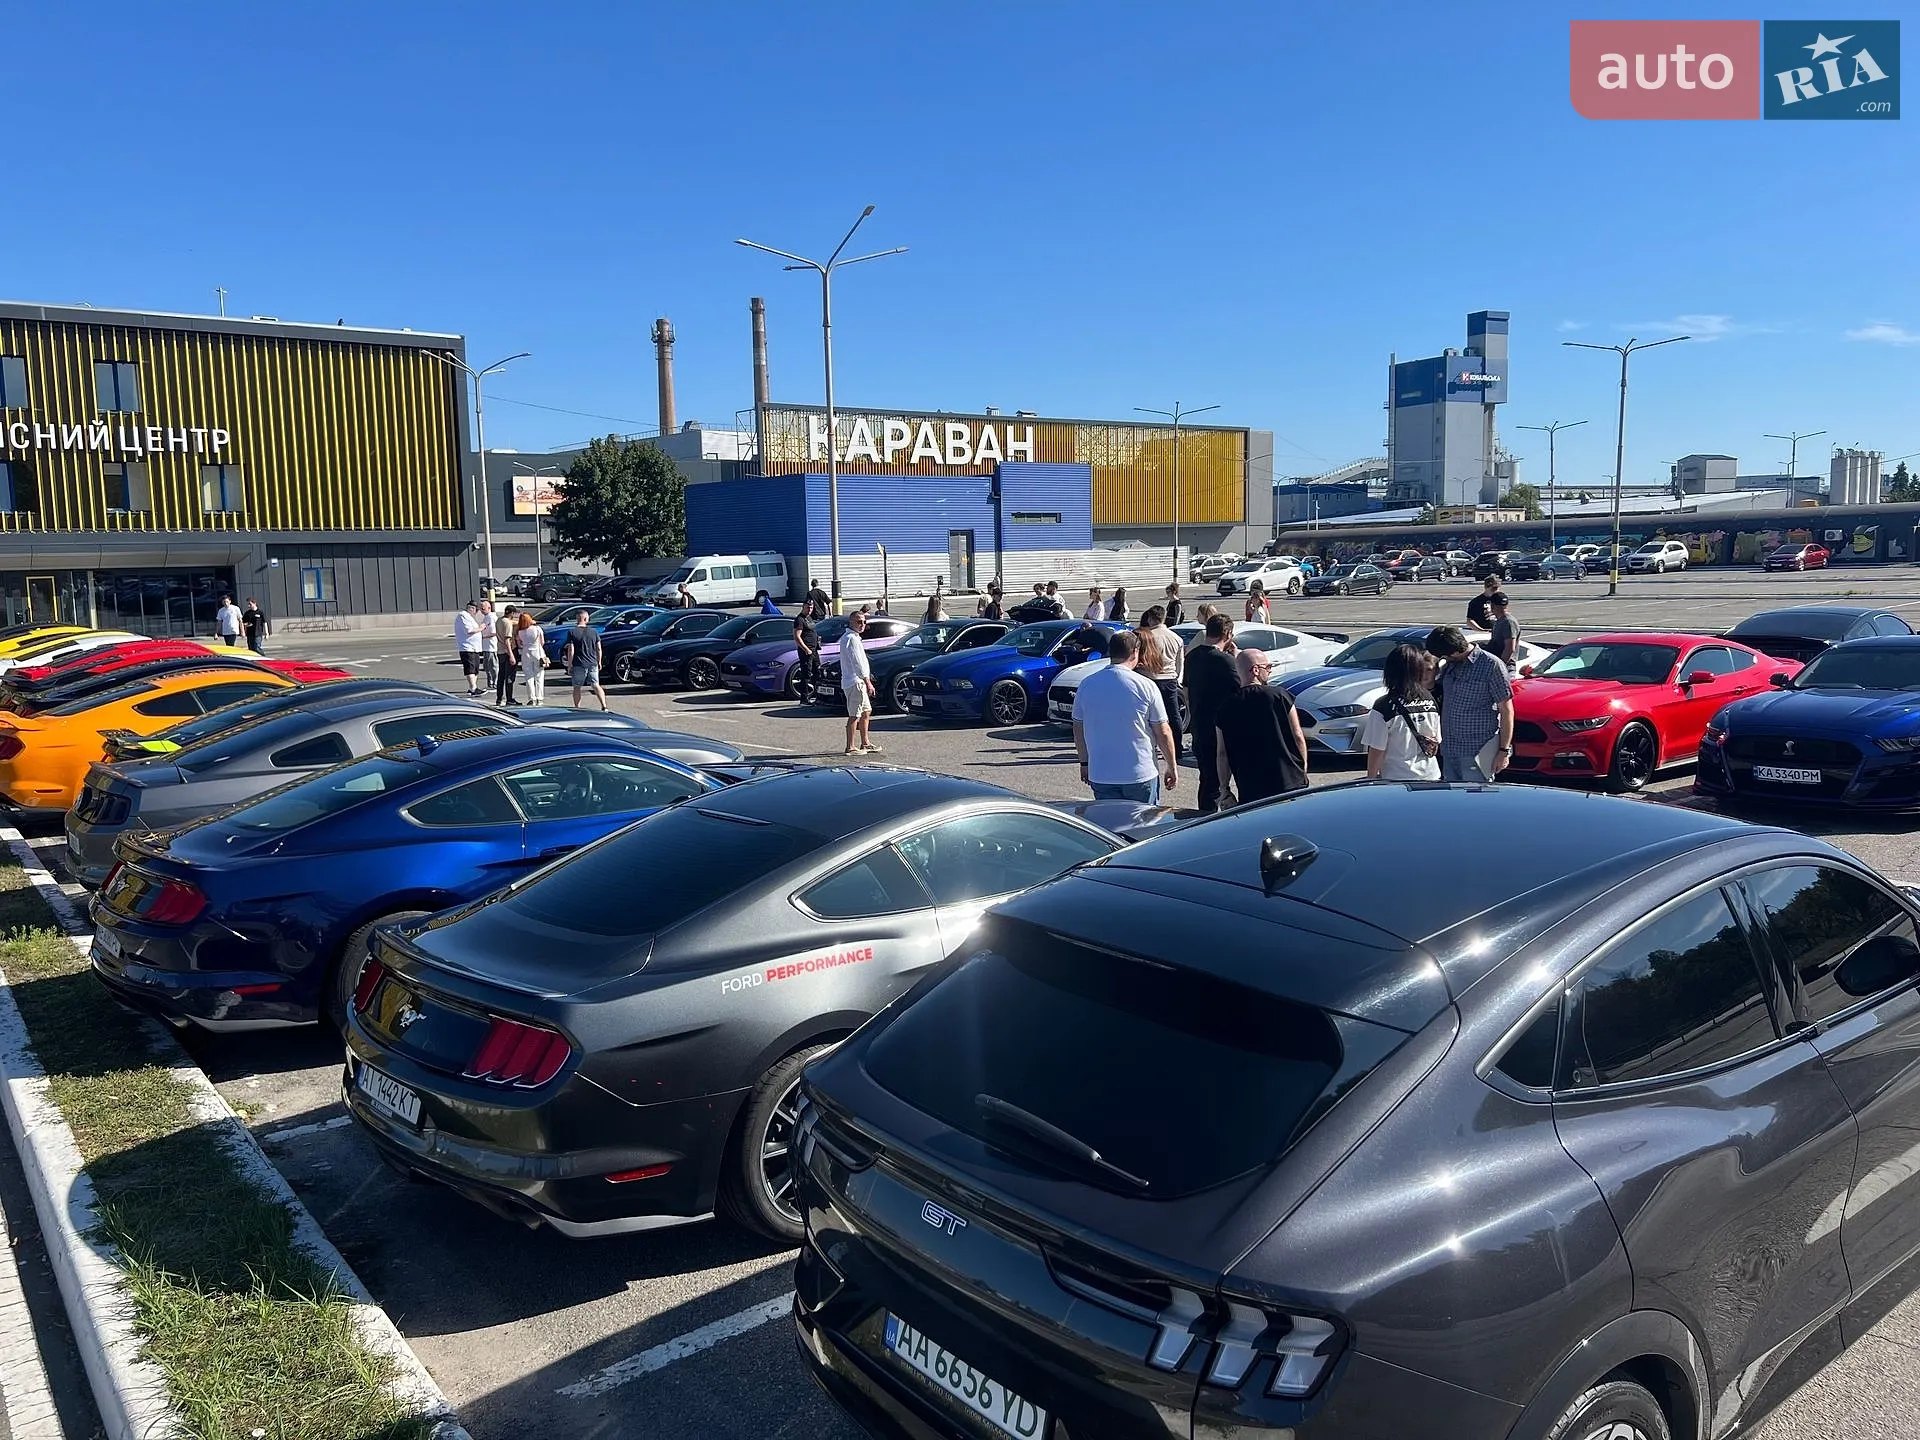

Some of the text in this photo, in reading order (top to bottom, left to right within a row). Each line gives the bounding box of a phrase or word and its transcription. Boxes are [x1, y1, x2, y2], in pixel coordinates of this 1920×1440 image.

[0, 419, 229, 457] СНИЙ ЦЕНТР
[808, 415, 1034, 466] КАРАВАН
[1758, 767, 1820, 781] KA 5340 PM
[721, 948, 874, 995] FORD PERFORMANCE
[377, 1075, 400, 1108] 1442
[398, 1087, 417, 1117] KT
[921, 1200, 968, 1236] GT
[886, 1329, 896, 1345] UA
[897, 1323, 929, 1369] AA
[934, 1345, 994, 1410] 6656
[1001, 1384, 1039, 1438] YD
